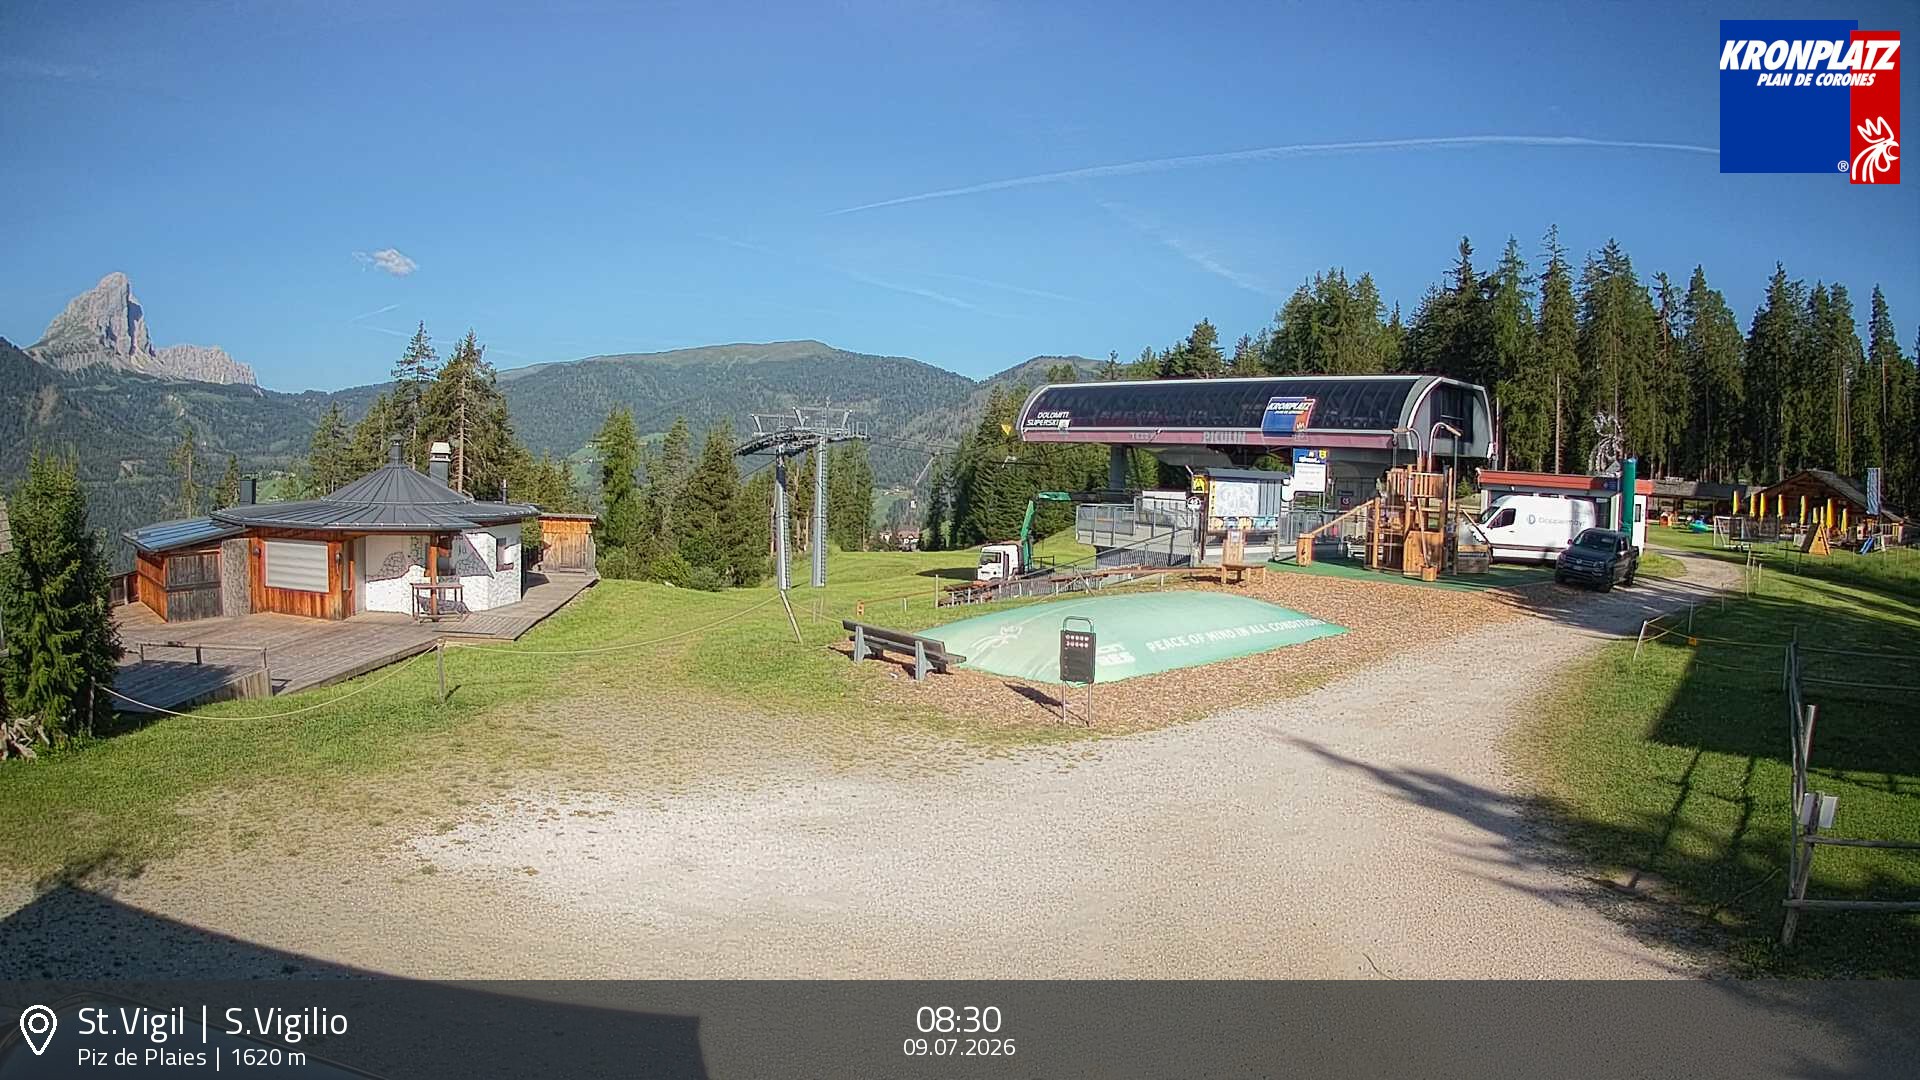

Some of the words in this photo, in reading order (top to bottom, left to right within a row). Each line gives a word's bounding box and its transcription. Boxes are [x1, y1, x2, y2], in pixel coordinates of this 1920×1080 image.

[1267, 402, 1312, 410] KRONPLATZ
[1037, 411, 1070, 419] DOLOMITI
[1145, 635, 1190, 652] PEACE
[1188, 632, 1207, 645] OF
[1206, 628, 1236, 642] MIND
[1249, 623, 1271, 635] ALL
